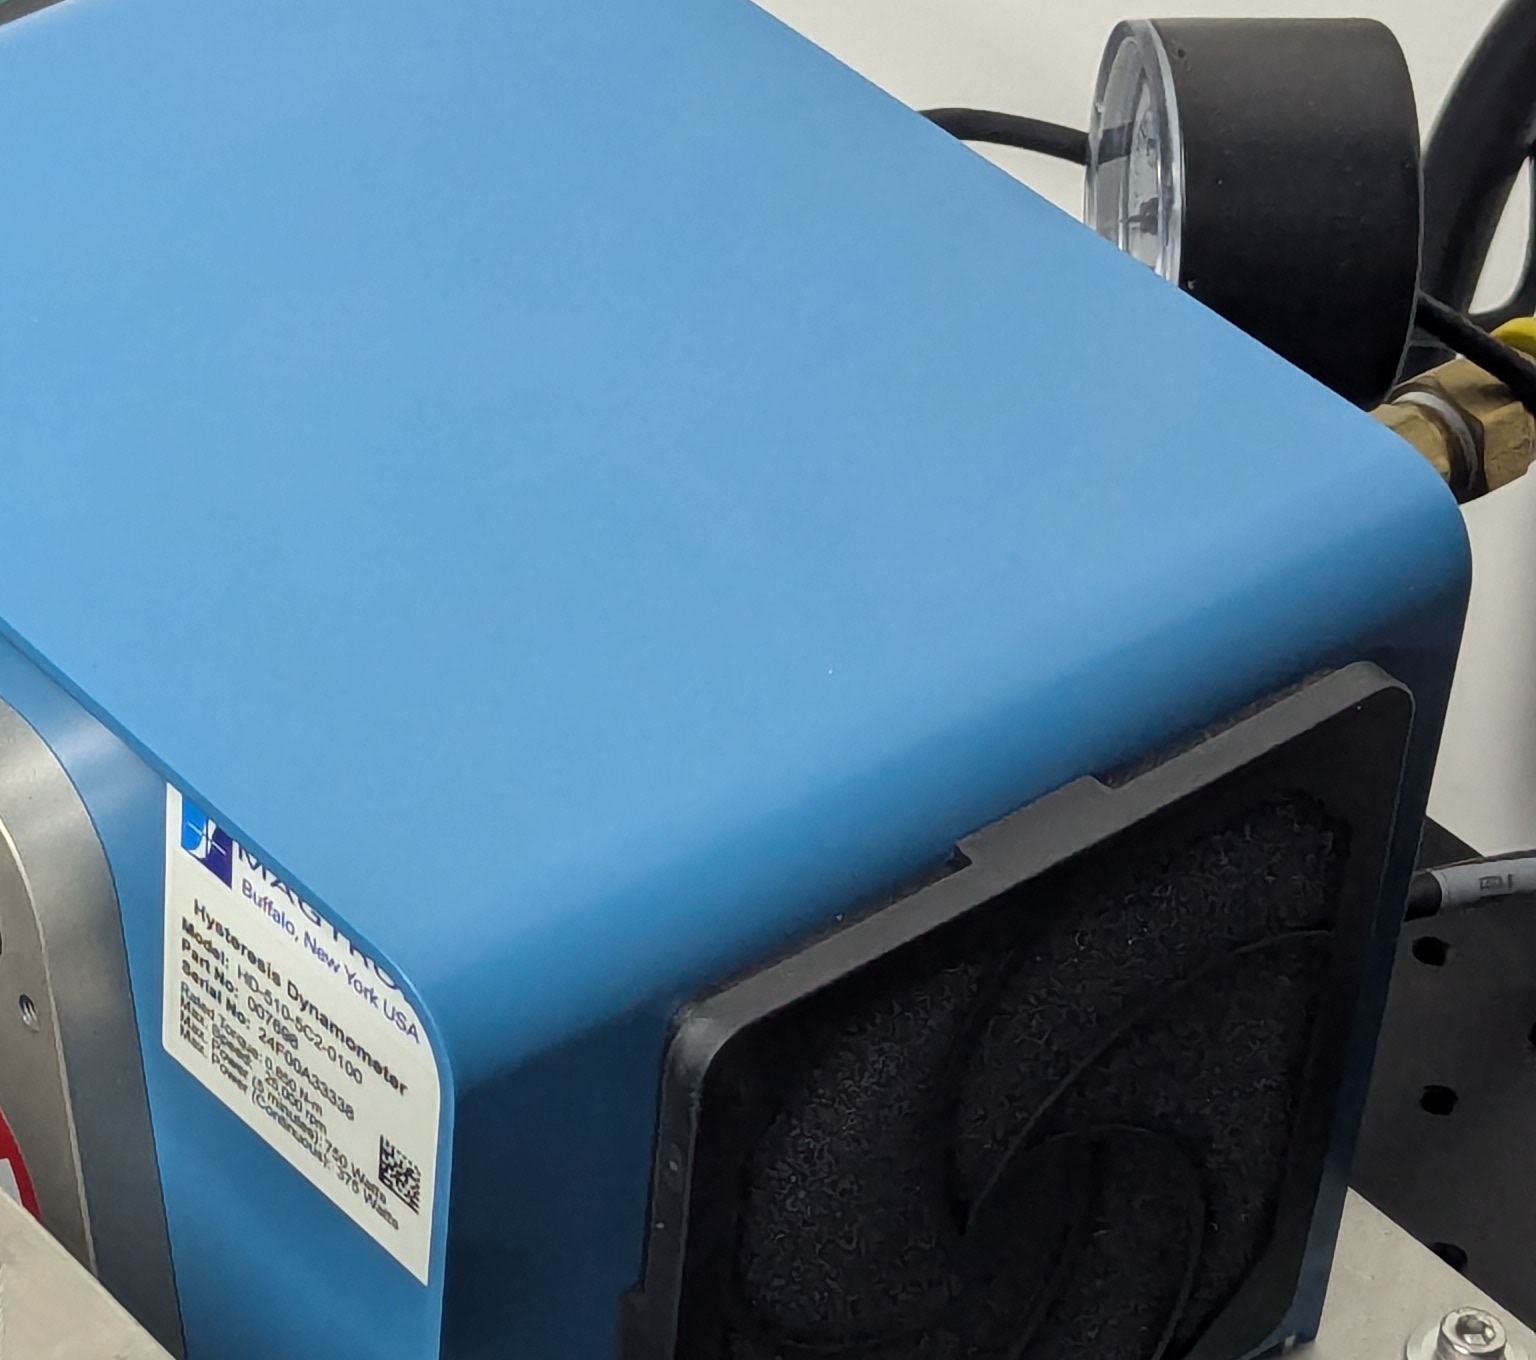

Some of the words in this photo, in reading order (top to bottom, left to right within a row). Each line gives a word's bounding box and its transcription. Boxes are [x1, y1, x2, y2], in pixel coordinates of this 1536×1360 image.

[180, 979, 214, 1020] Rated
[217, 1012, 262, 1063] Torque:
[181, 936, 210, 973] Part
[213, 965, 238, 998] No:
[181, 956, 222, 1004] Serial
[225, 996, 250, 1030] No:
[181, 915, 229, 968] Model:
[237, 963, 363, 1085] HD-510-5C2-0100
[193, 898, 281, 986] Hysteresis
[286, 979, 408, 1096] Dynamometer
[241, 876, 298, 941] Buffalo,
[303, 929, 339, 974] New
[343, 964, 378, 1008] York
[382, 998, 420, 1044] USA
[210, 1050, 248, 1094] Power
[362, 1187, 400, 1230] Watts
[211, 1036, 248, 1079] Power
[350, 1162, 387, 1204] Watts
[304, 1108, 327, 1135] rpm
